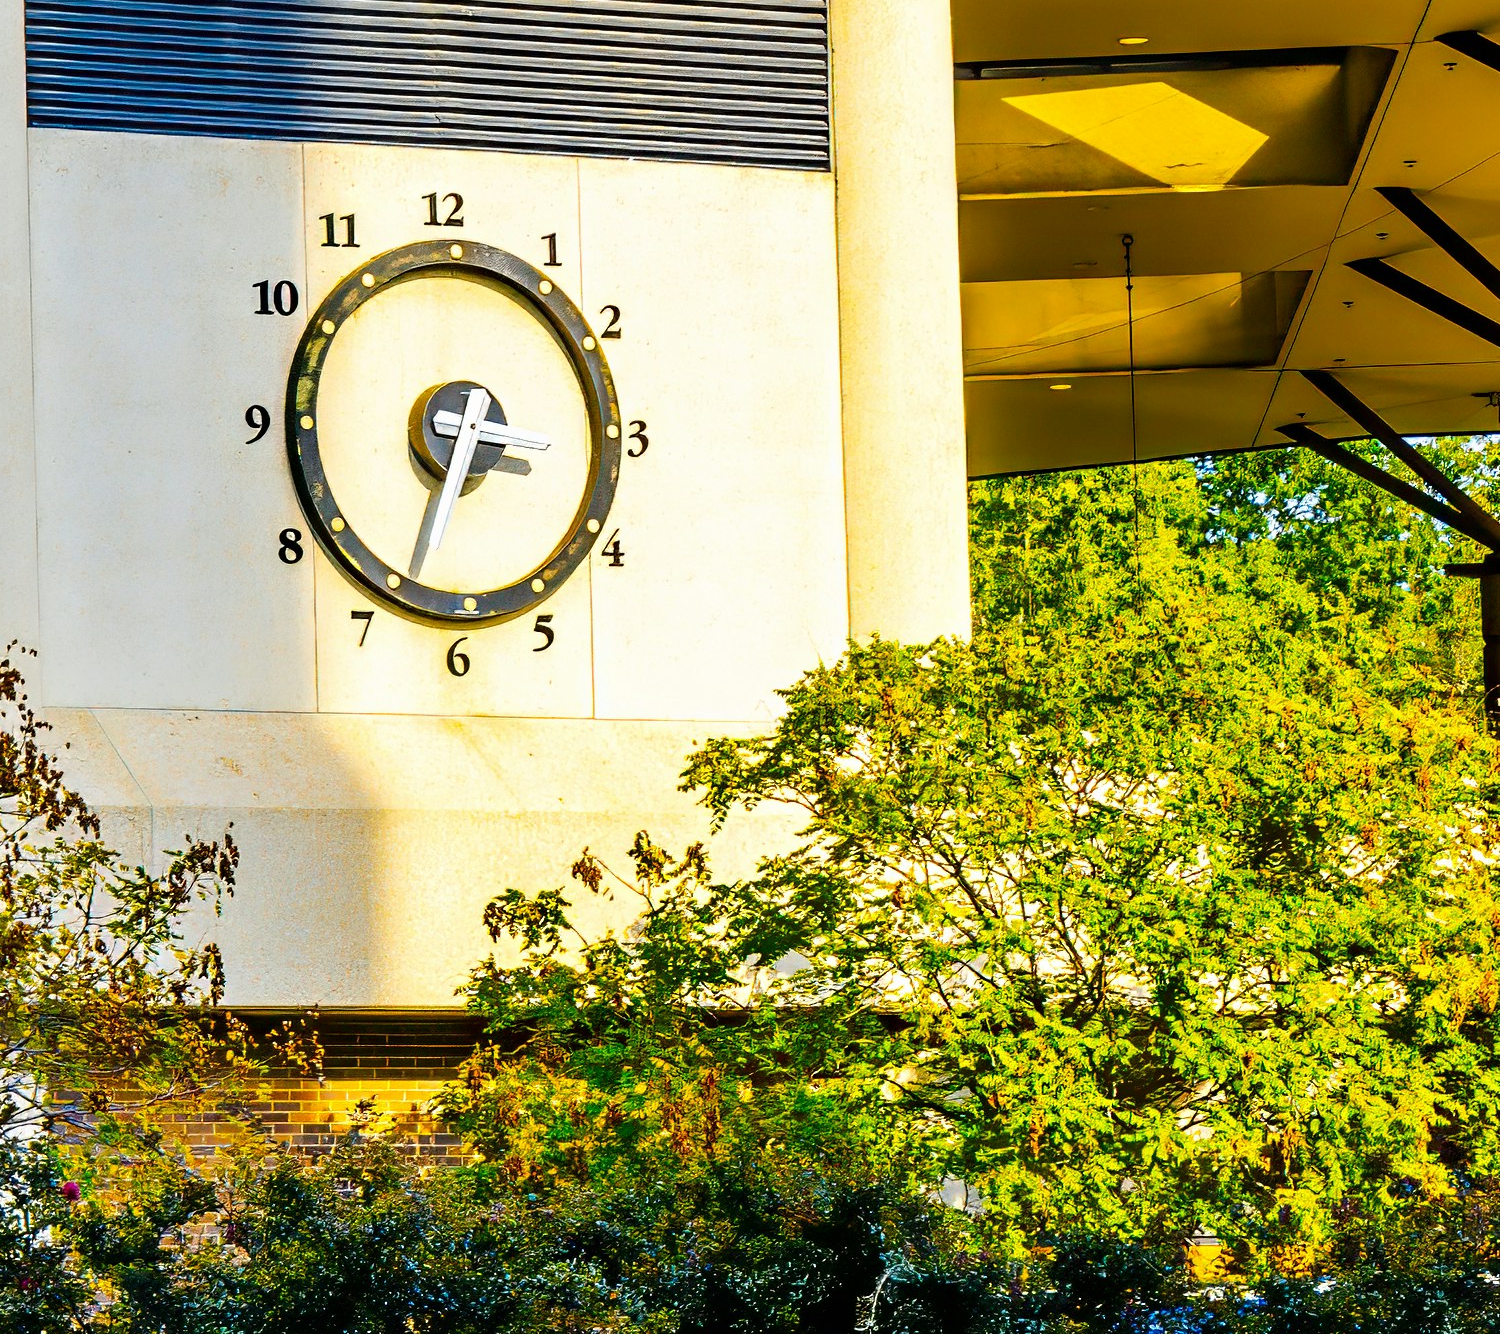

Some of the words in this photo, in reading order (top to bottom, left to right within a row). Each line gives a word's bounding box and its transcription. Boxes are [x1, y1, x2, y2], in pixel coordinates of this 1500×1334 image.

[421, 192, 465, 227] 12
[319, 212, 360, 248] 11
[541, 232, 563, 267] 1
[252, 280, 298, 317] 10
[600, 304, 623, 339] 2
[245, 404, 271, 445] 9
[627, 420, 650, 458] 3
[278, 527, 304, 565] 8
[601, 528, 626, 568] 4
[350, 610, 376, 647] 7
[532, 614, 555, 652] 5
[446, 637, 471, 677] 6
